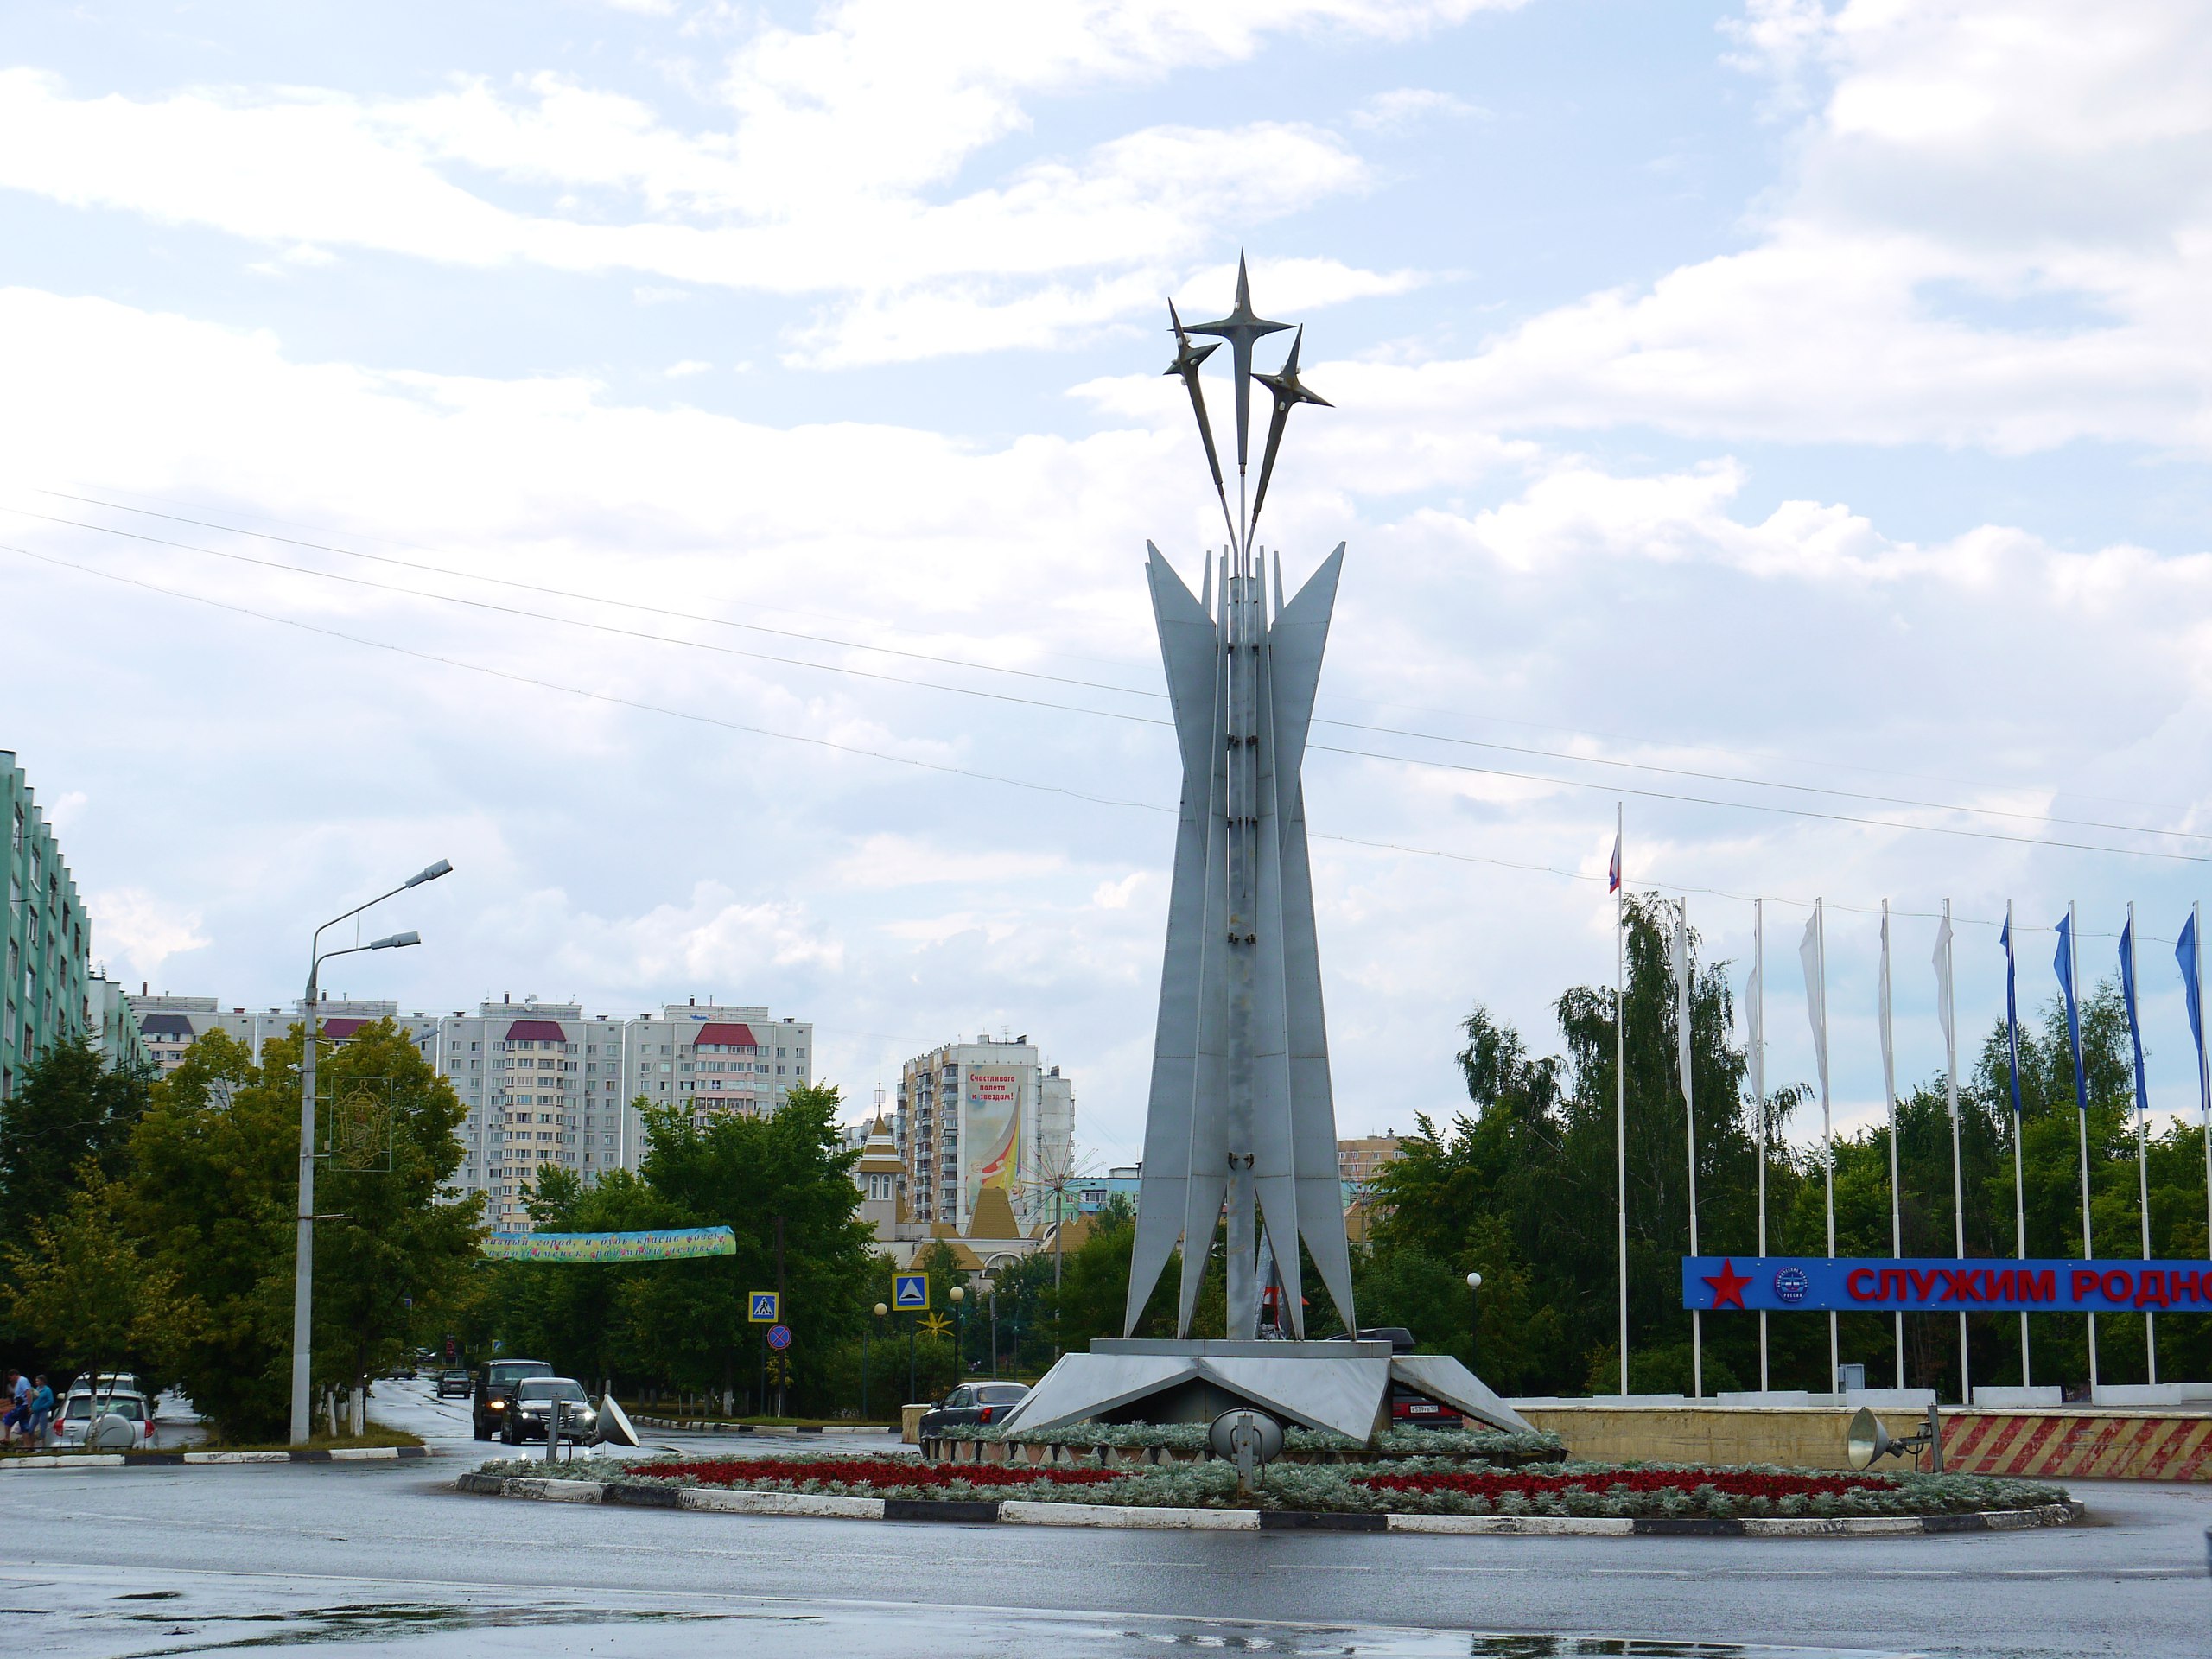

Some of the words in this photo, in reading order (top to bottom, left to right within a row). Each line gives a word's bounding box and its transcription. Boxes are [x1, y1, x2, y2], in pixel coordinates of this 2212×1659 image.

[969, 1073, 1015, 1083] Счастливого
[980, 1092, 1014, 1102] звездам!
[484, 1237, 529, 1246] лавный
[601, 1236, 628, 1248] будь
[636, 1235, 679, 1247] красив
[1847, 1268, 2056, 1301] СЛУЖИМ
